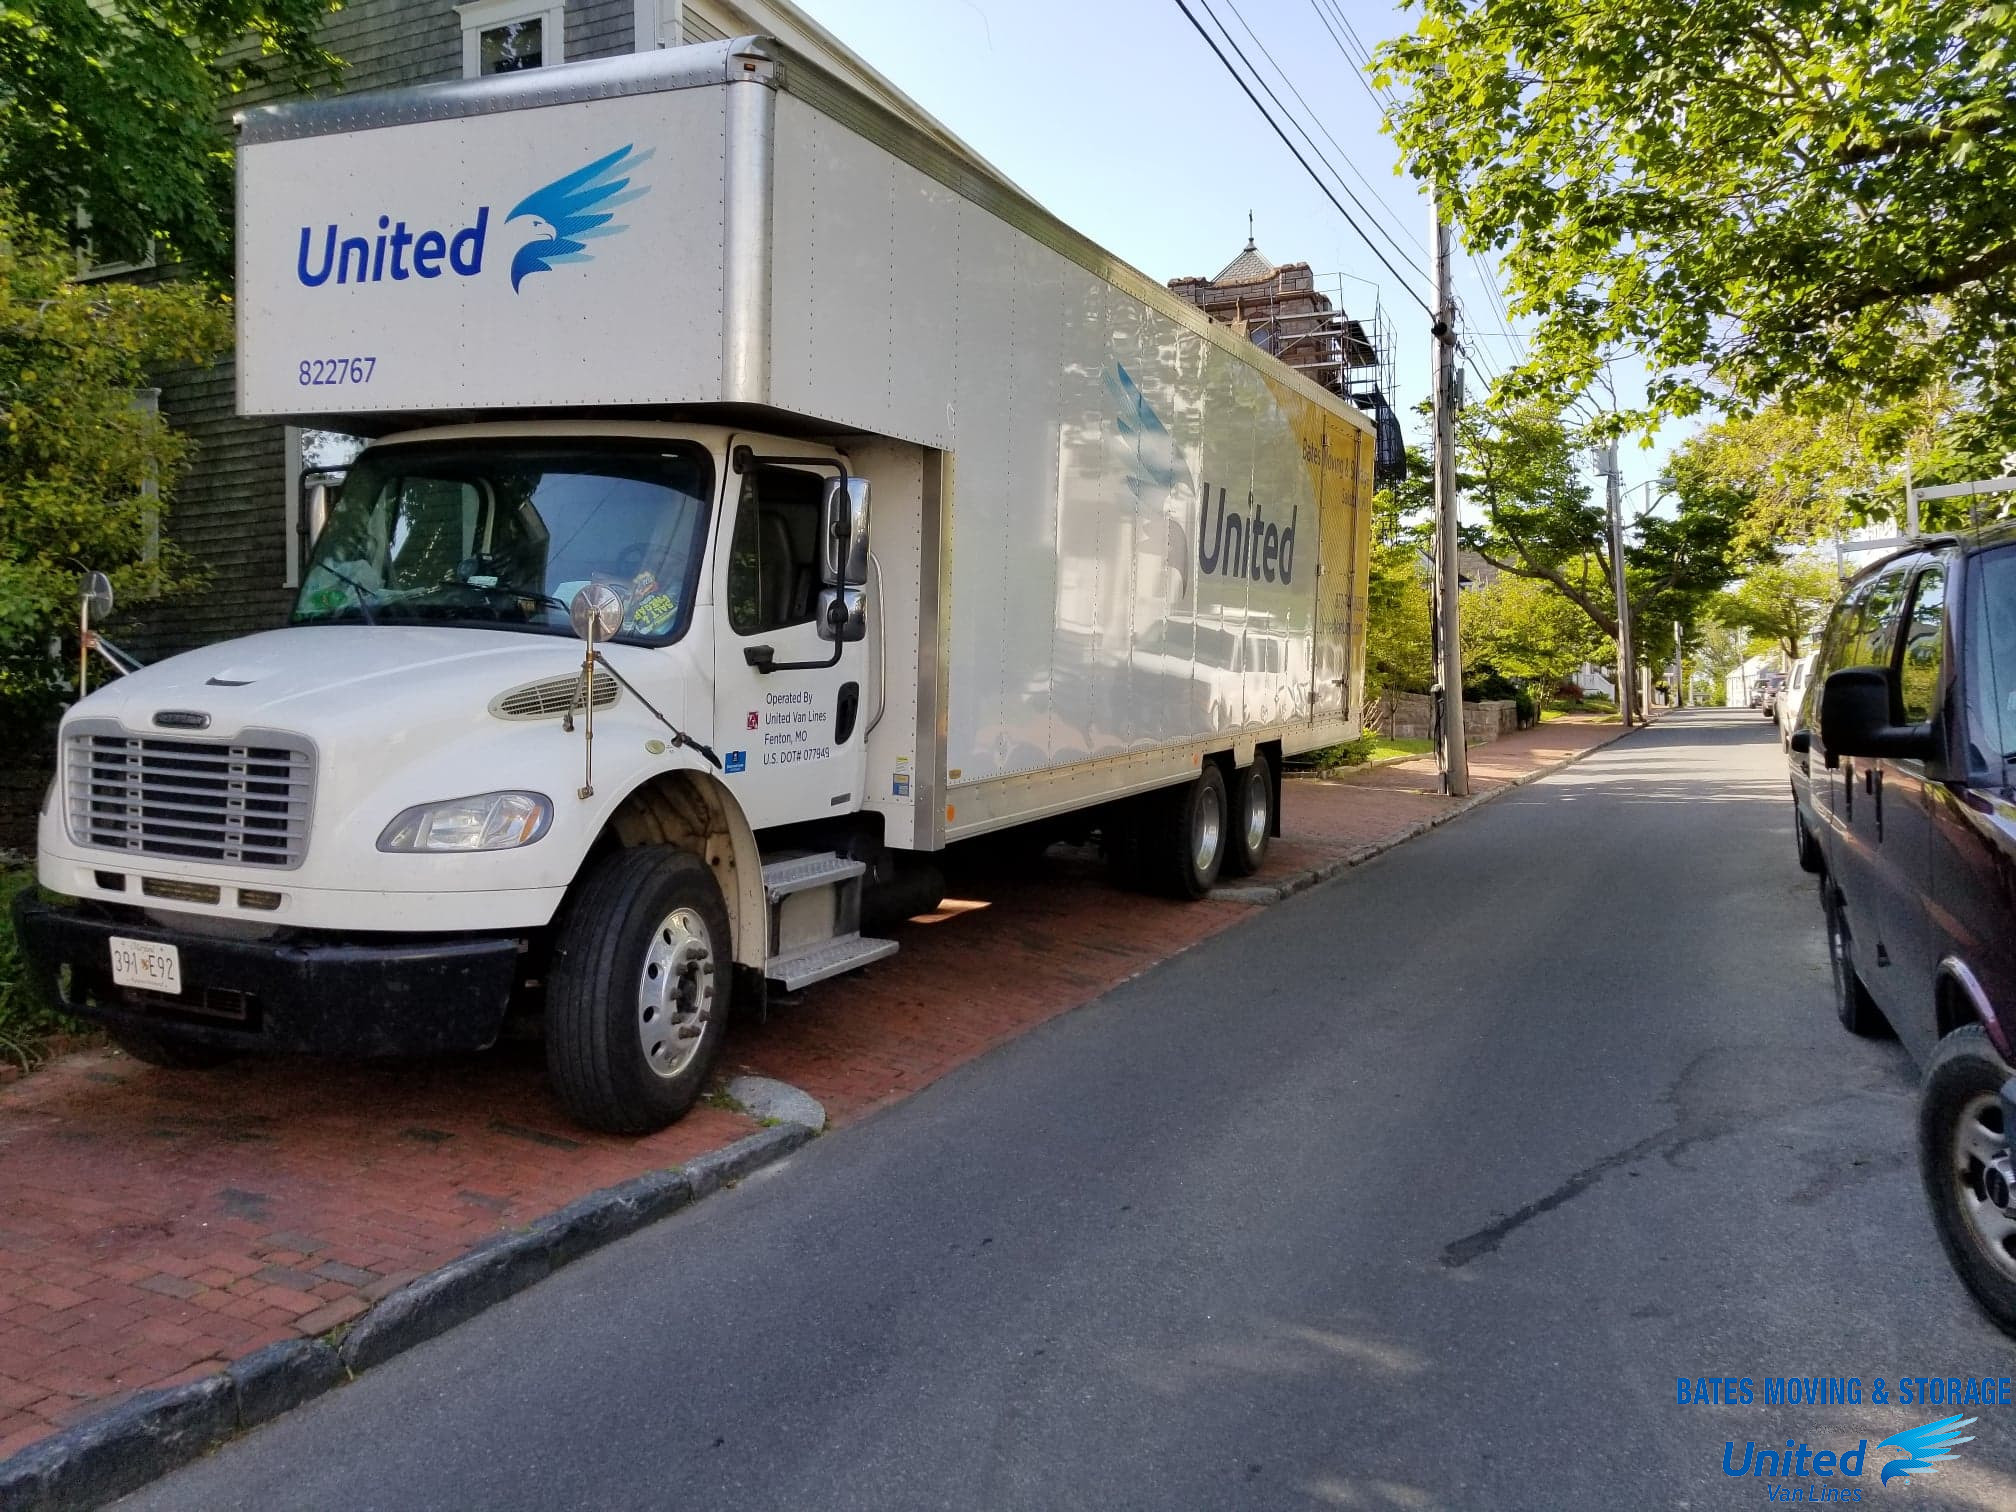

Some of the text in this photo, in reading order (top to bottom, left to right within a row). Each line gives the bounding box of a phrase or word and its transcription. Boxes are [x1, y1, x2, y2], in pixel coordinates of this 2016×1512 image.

[297, 206, 490, 287] United
[299, 357, 376, 386] 822767
[1199, 483, 1297, 585] United
[766, 691, 813, 706] Operated By
[765, 711, 791, 725] United
[793, 711, 807, 723] Van
[808, 710, 827, 722] Lines
[764, 730, 808, 745] Fenton, MO
[763, 747, 830, 766] U.S. DOT# 077949
[114, 950, 175, 981] 391 E92
